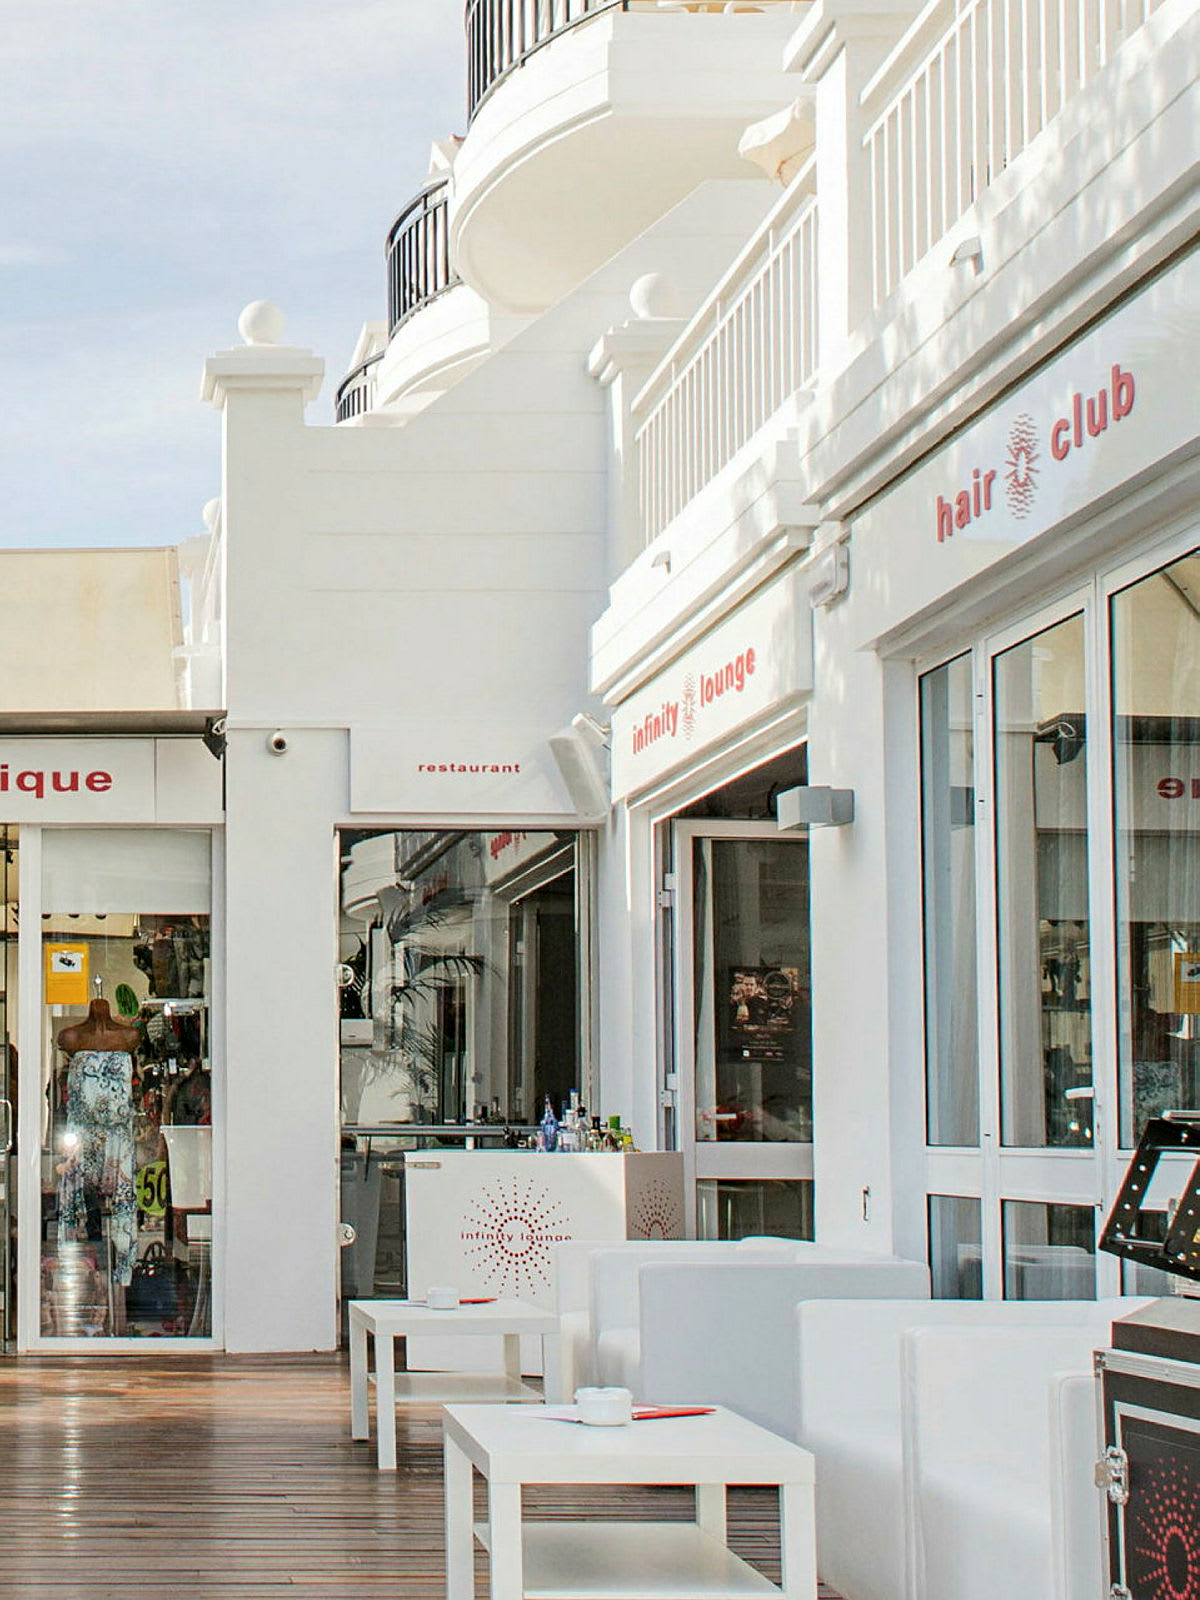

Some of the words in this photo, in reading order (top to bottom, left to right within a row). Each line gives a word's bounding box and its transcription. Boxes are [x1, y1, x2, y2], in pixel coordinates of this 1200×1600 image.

[936, 468, 997, 543] hair
[1050, 363, 1136, 461] club
[632, 701, 679, 755] infinity
[700, 647, 756, 708] lounge
[417, 762, 521, 774] restaurant
[460, 1231, 514, 1242] infinity
